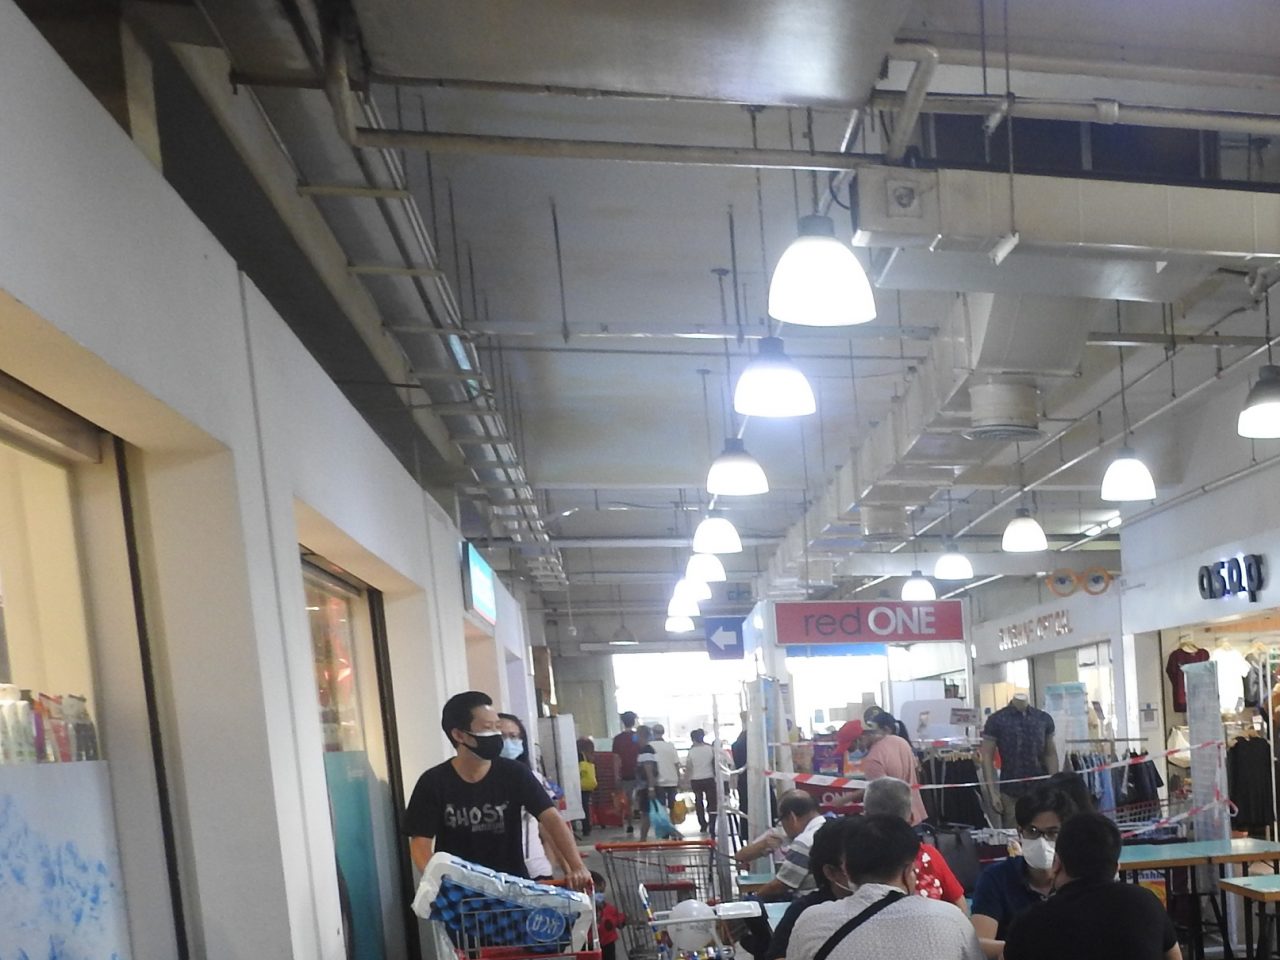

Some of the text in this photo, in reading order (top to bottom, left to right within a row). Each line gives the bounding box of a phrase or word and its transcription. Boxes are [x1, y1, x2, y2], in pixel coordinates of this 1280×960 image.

[803, 606, 937, 637] red ONE
[444, 803, 508, 829] GHOST
